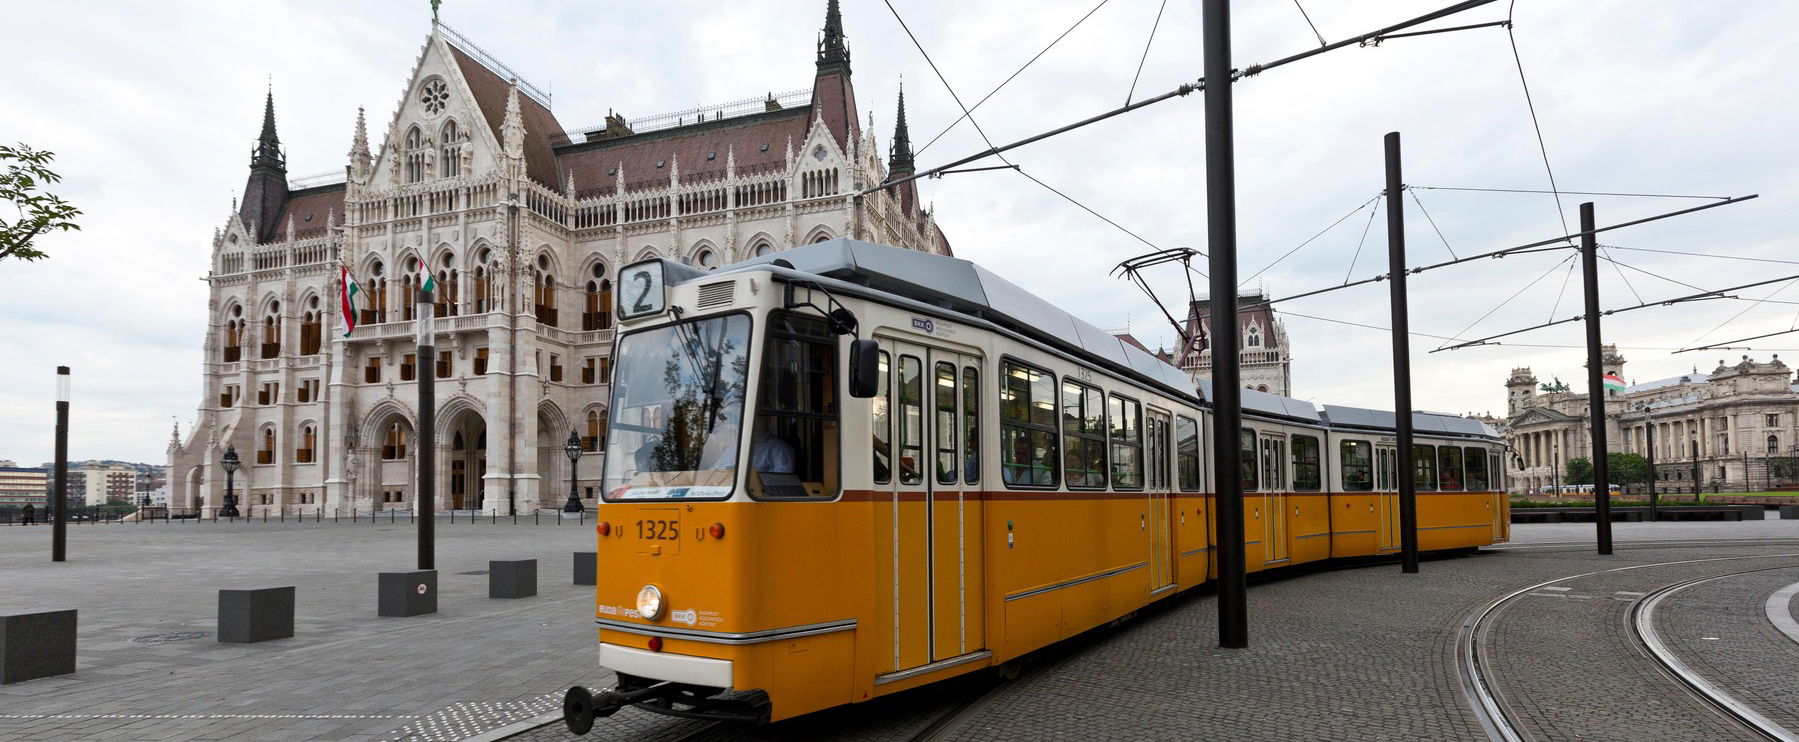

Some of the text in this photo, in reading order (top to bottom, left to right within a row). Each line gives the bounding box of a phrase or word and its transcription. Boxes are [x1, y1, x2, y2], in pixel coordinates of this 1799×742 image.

[633, 271, 653, 313] 2
[1077, 366, 1092, 383] 1325
[636, 520, 678, 540] 1325
